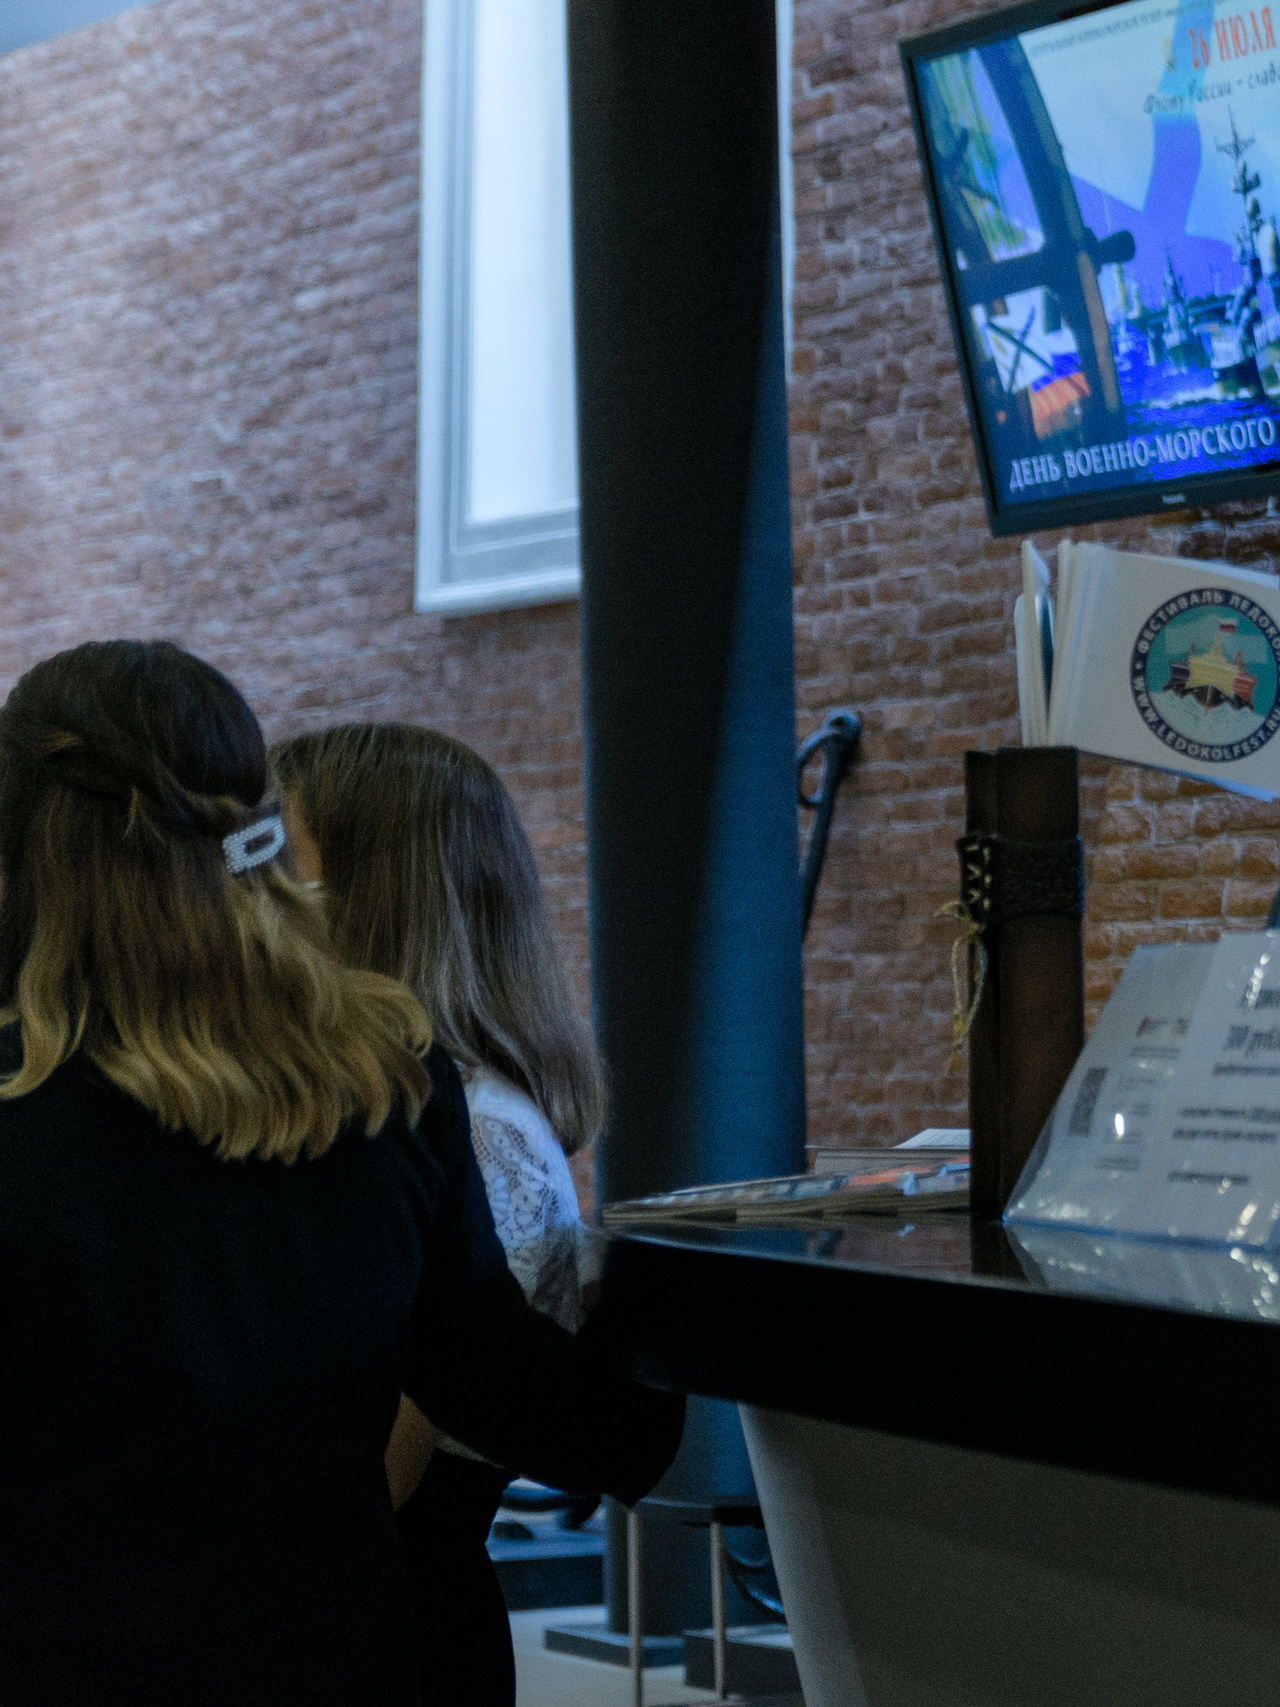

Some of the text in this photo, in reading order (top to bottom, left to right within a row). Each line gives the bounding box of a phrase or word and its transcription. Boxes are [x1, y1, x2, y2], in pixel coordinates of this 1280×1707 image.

[1188, 27, 1211, 69] 26
[1214, 6, 1277, 62] ИЮЛЯ
[1009, 454, 1062, 493] ДЕНЬ
[1065, 417, 1276, 478] ВОЕННО-МОРСКОГО
[1137, 590, 1225, 654] ФЕСТИВАЛЬ
